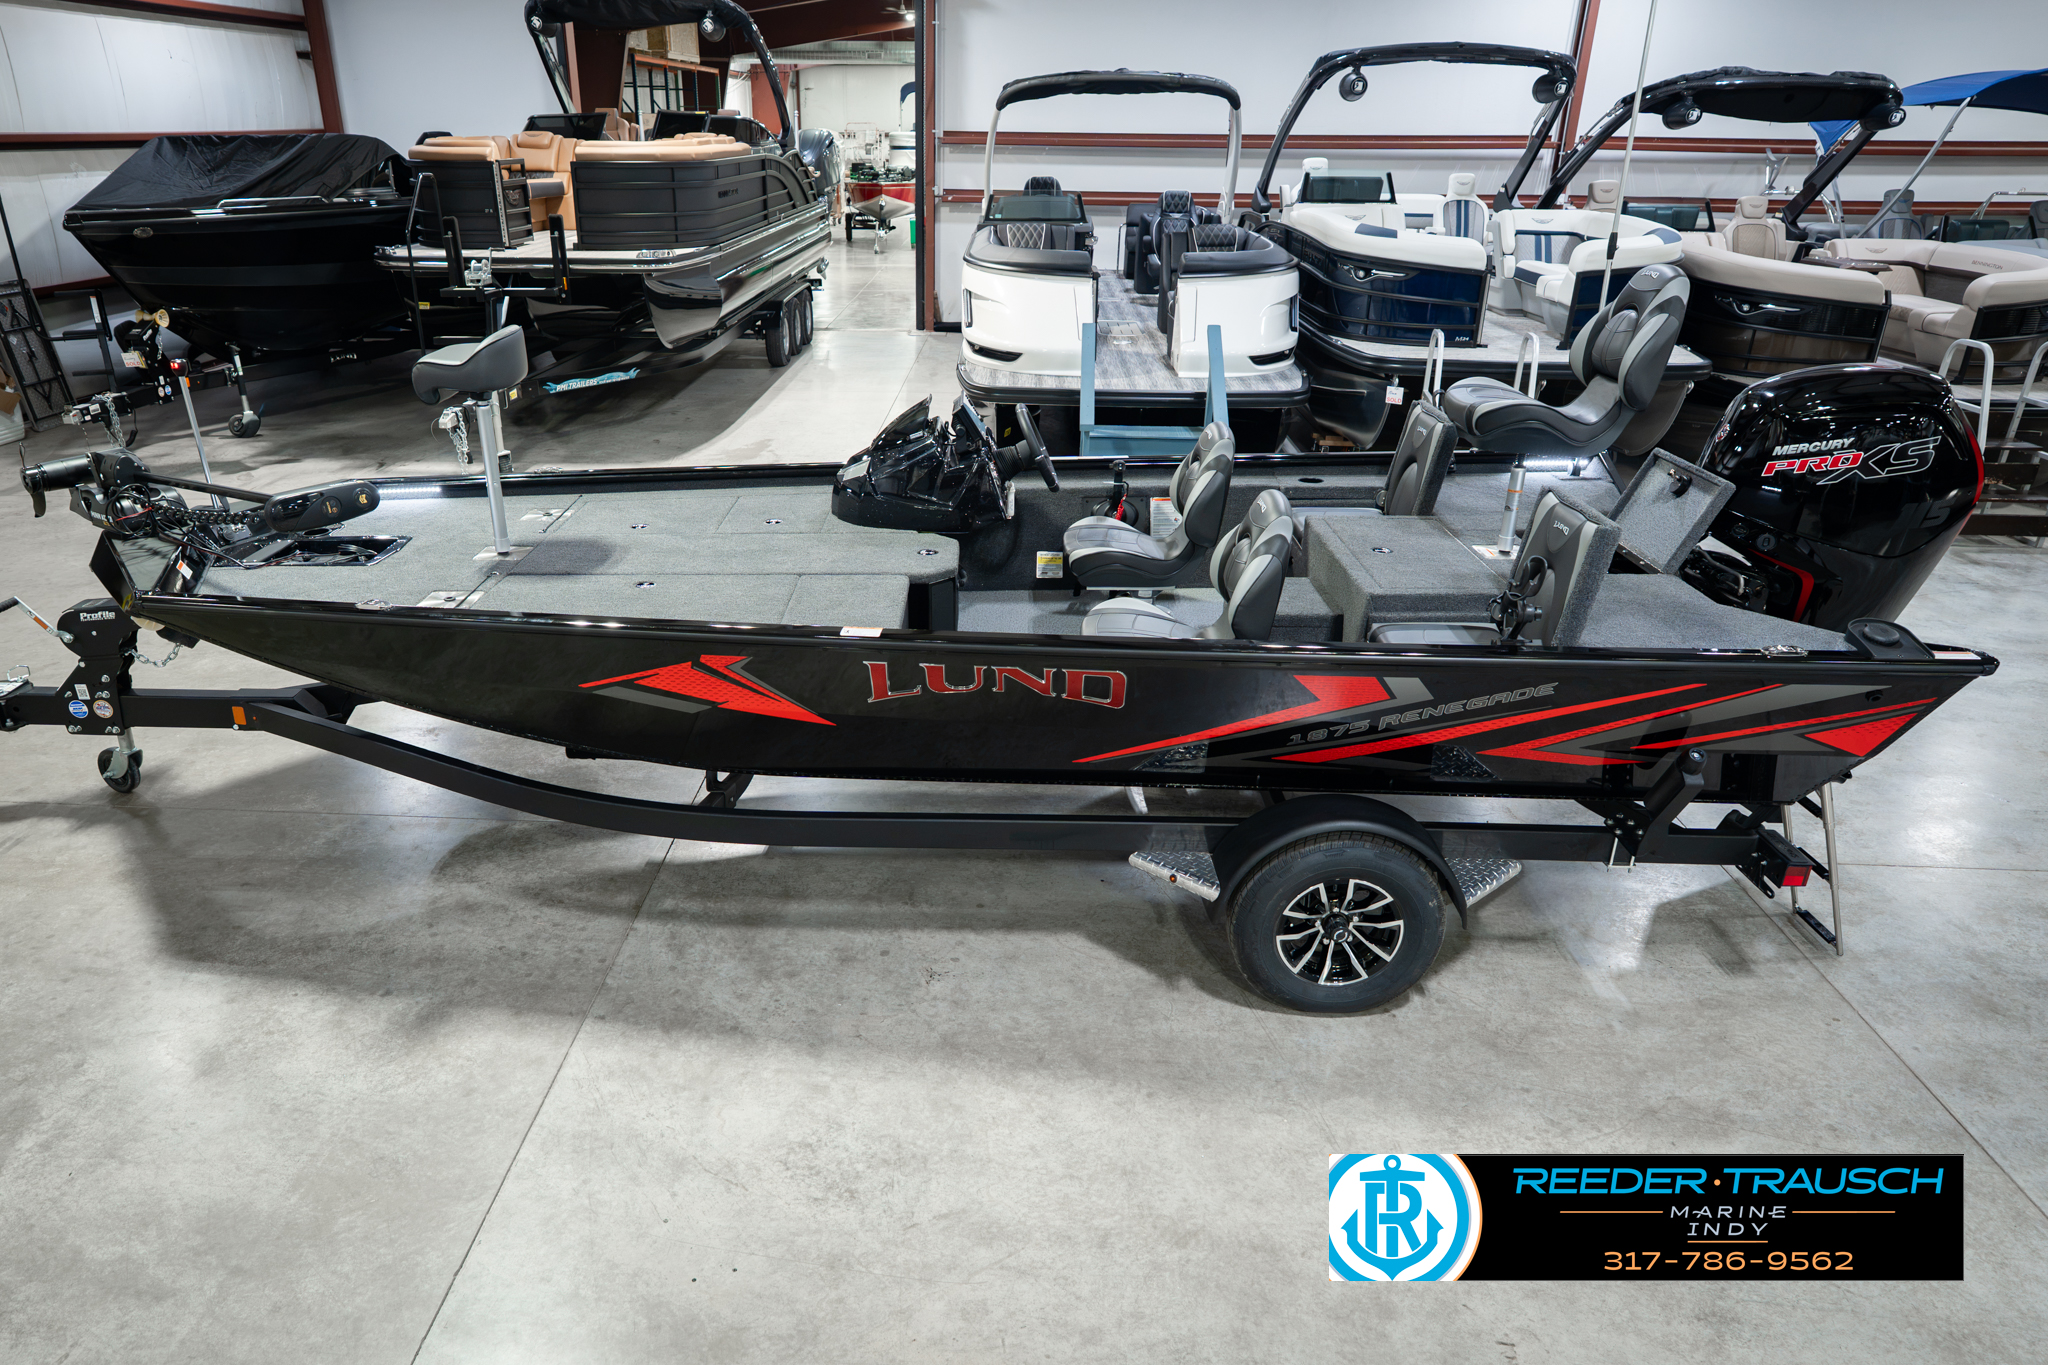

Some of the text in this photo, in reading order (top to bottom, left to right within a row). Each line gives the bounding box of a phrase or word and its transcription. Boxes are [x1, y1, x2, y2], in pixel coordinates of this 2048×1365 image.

[1971, 260, 2003, 270] BENNINGTON
[569, 378, 598, 389] TRAILERS
[1386, 396, 1402, 404] SOLD
[1772, 438, 1855, 456] MERCURY
[1761, 436, 1942, 486] PRO XS
[79, 610, 116, 620] Profile
[863, 661, 1127, 709] LUND
[1286, 681, 1559, 746] 1875 RENEGADE
